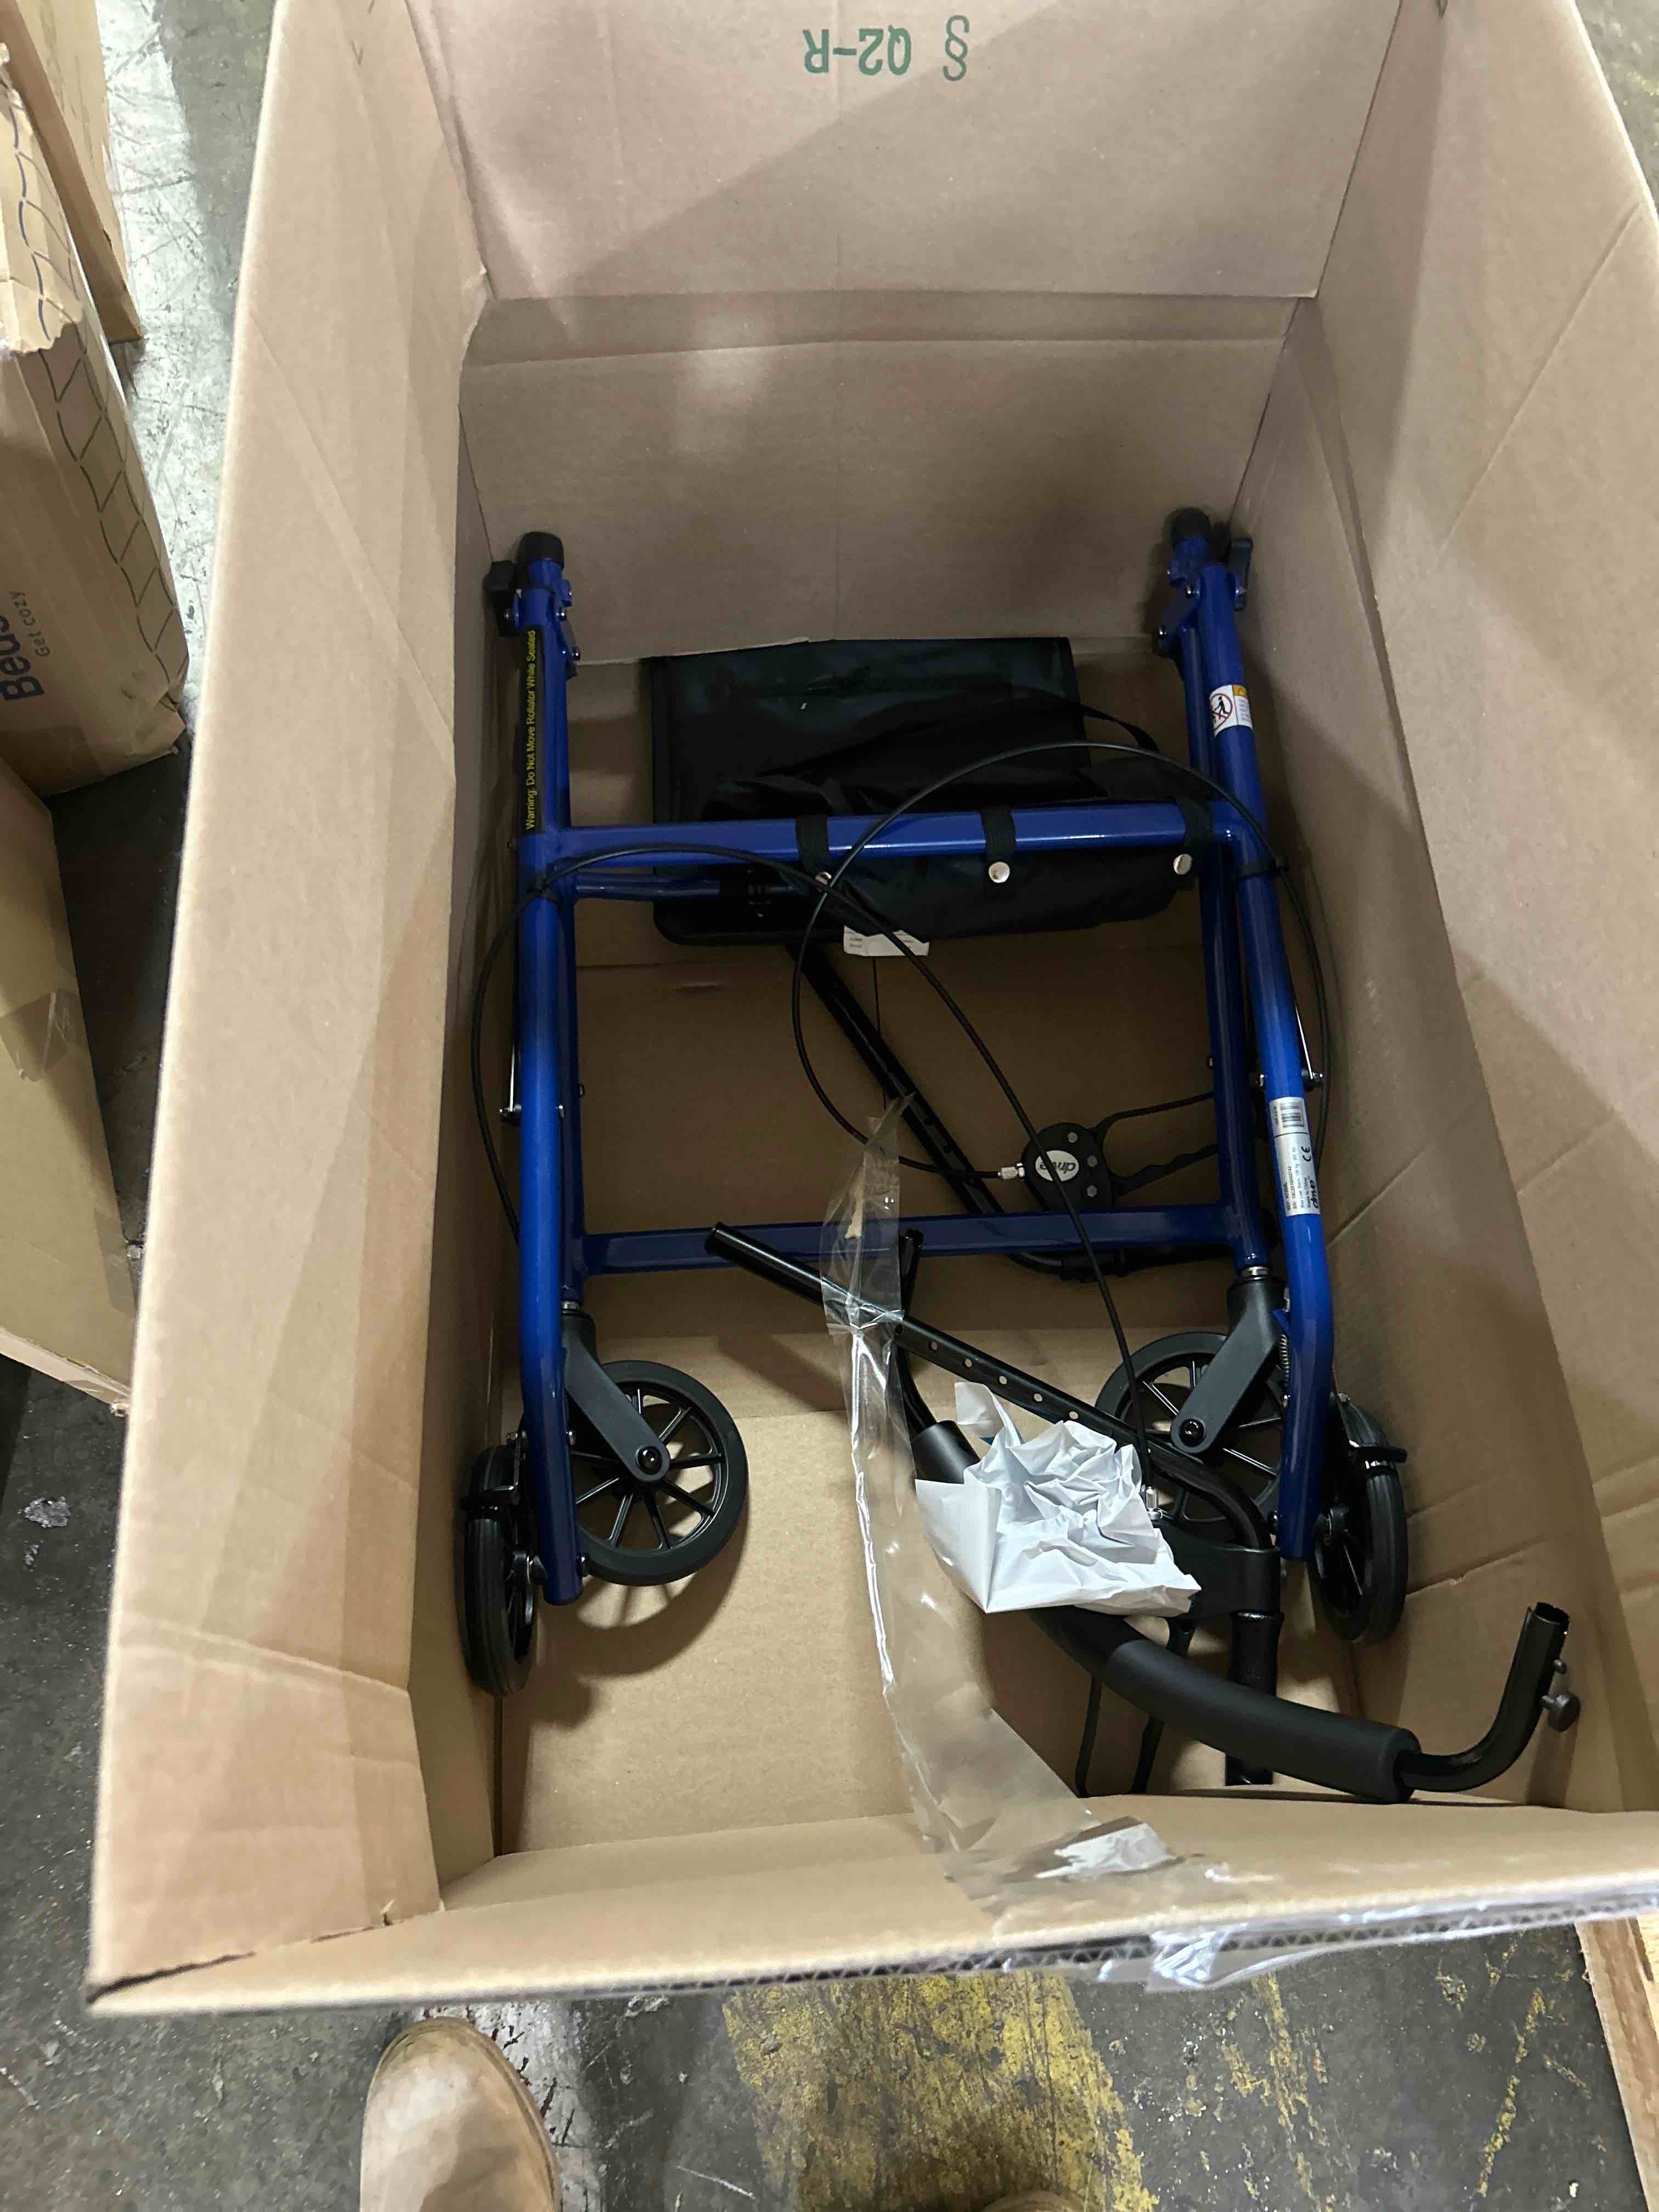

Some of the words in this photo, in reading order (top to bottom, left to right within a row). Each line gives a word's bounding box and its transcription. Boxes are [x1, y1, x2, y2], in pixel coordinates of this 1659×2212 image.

[802, 25, 912, 76] Q2-R
[8, 591, 36, 627] cozy
[28, 630, 52, 657] Get
[526, 663, 535, 687] While
[526, 691, 535, 725] Rollator
[526, 726, 535, 752] Move
[526, 753, 535, 770] Not
[526, 771, 535, 786] Do
